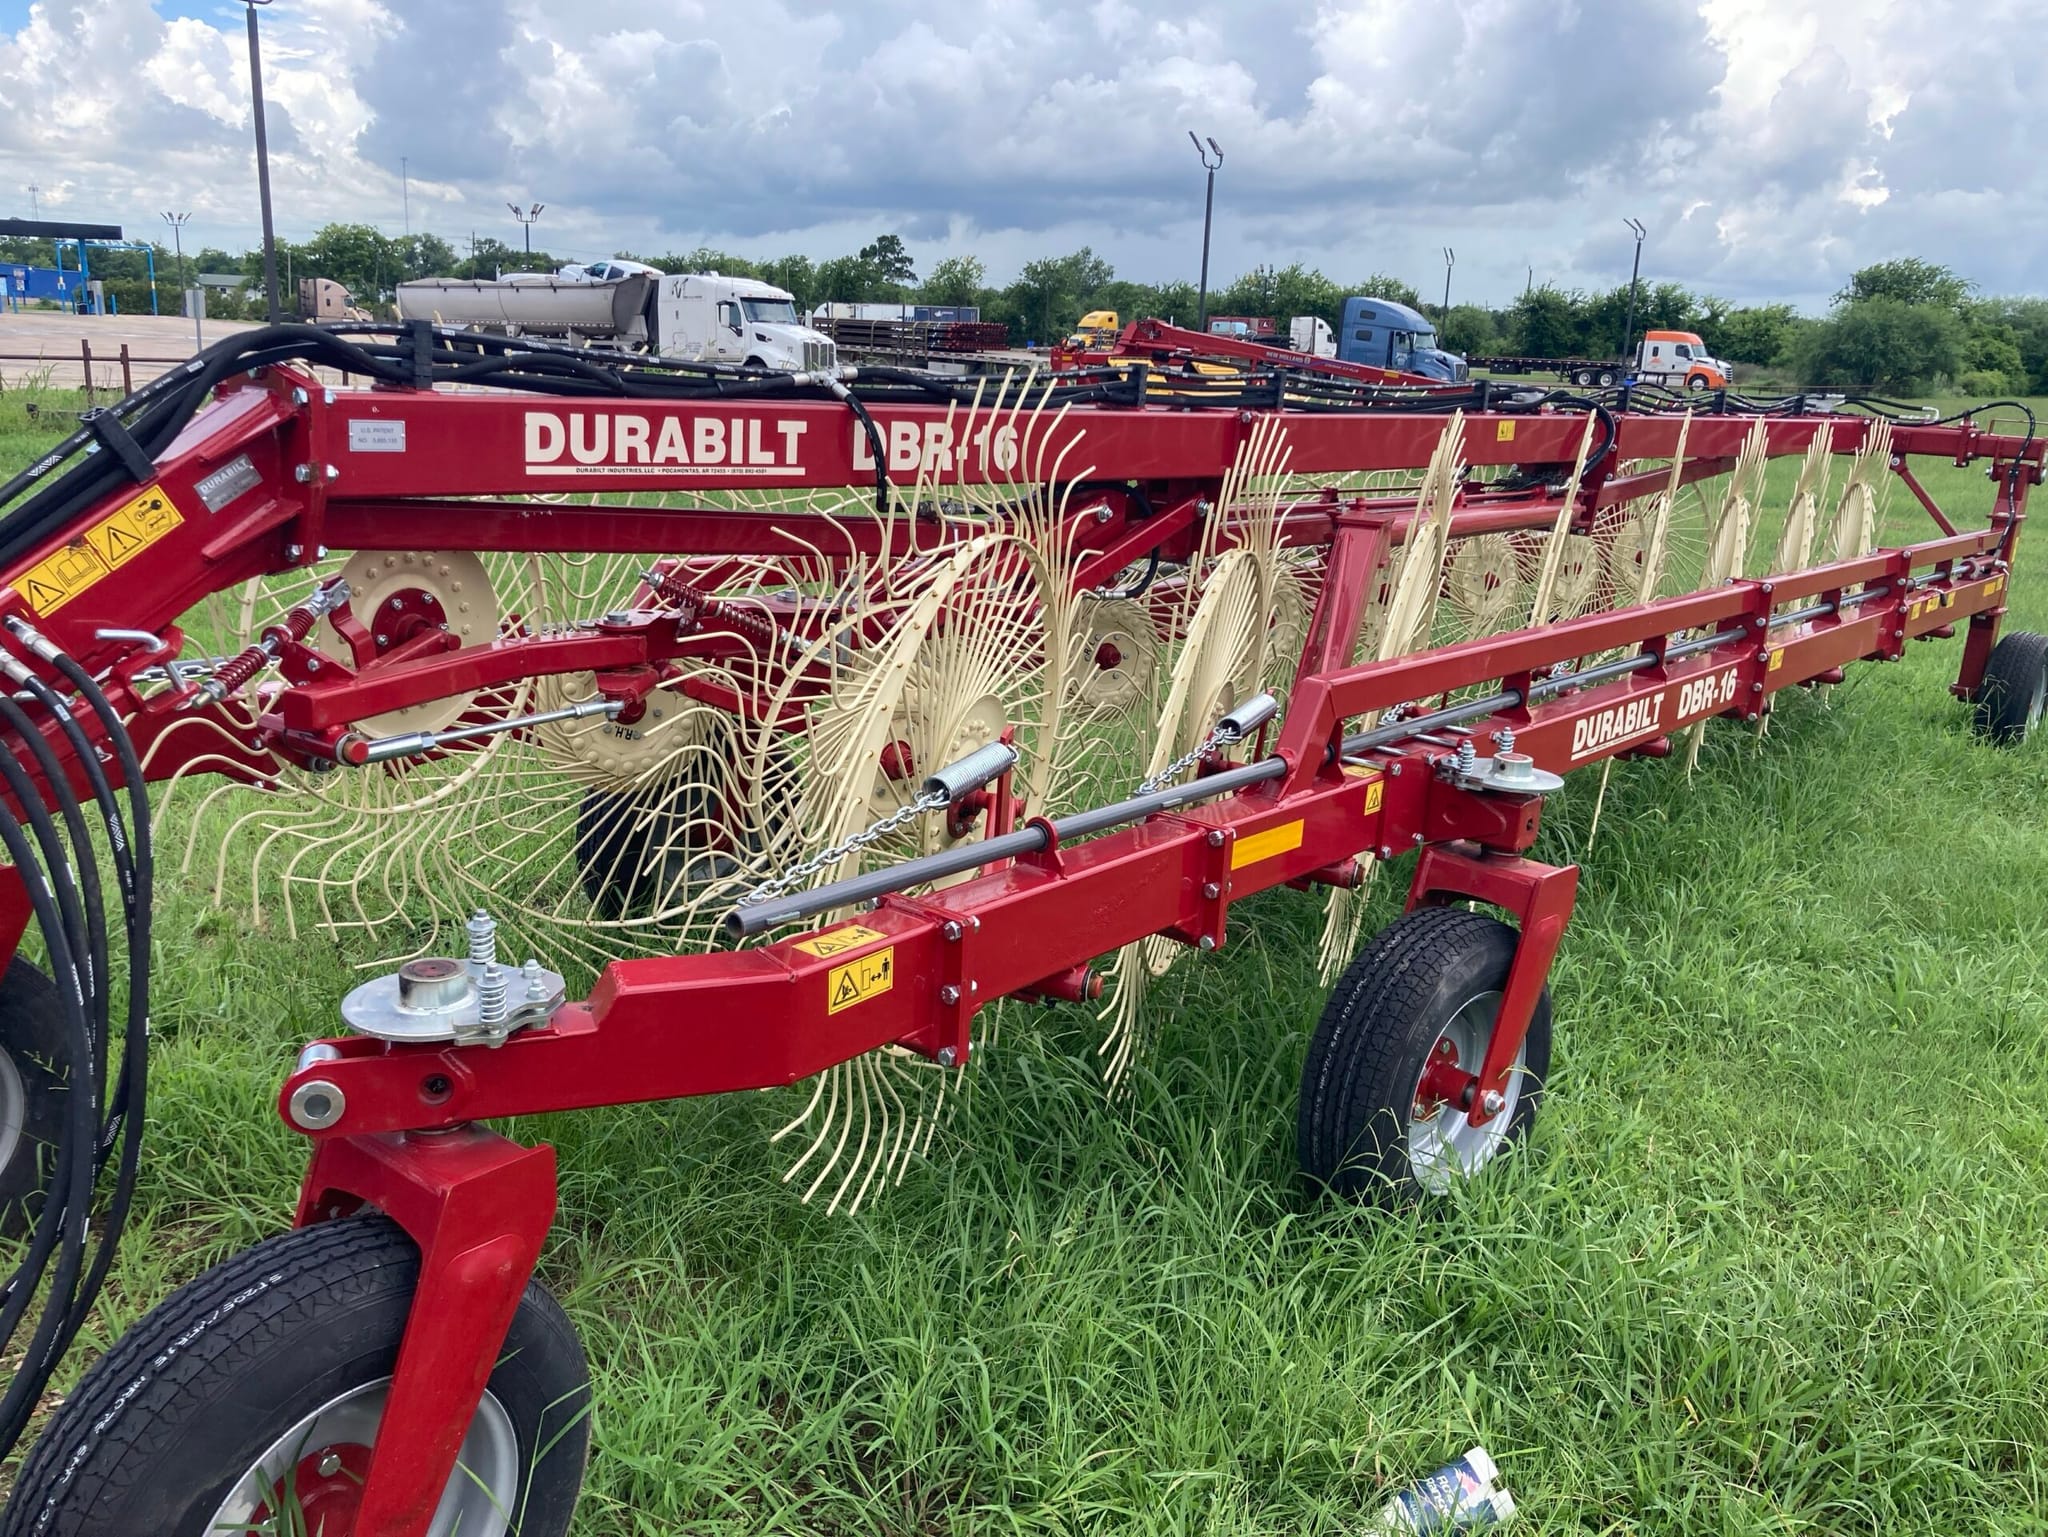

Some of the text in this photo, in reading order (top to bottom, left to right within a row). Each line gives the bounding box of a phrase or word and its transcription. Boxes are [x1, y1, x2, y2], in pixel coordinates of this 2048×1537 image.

[525, 412, 1018, 471] DURABILT DBR-16
[199, 458, 248, 494] DURABILT
[615, 725, 633, 740] R.H.
[1572, 692, 1665, 753] DURABILT
[1677, 668, 1738, 720] DBR-16
